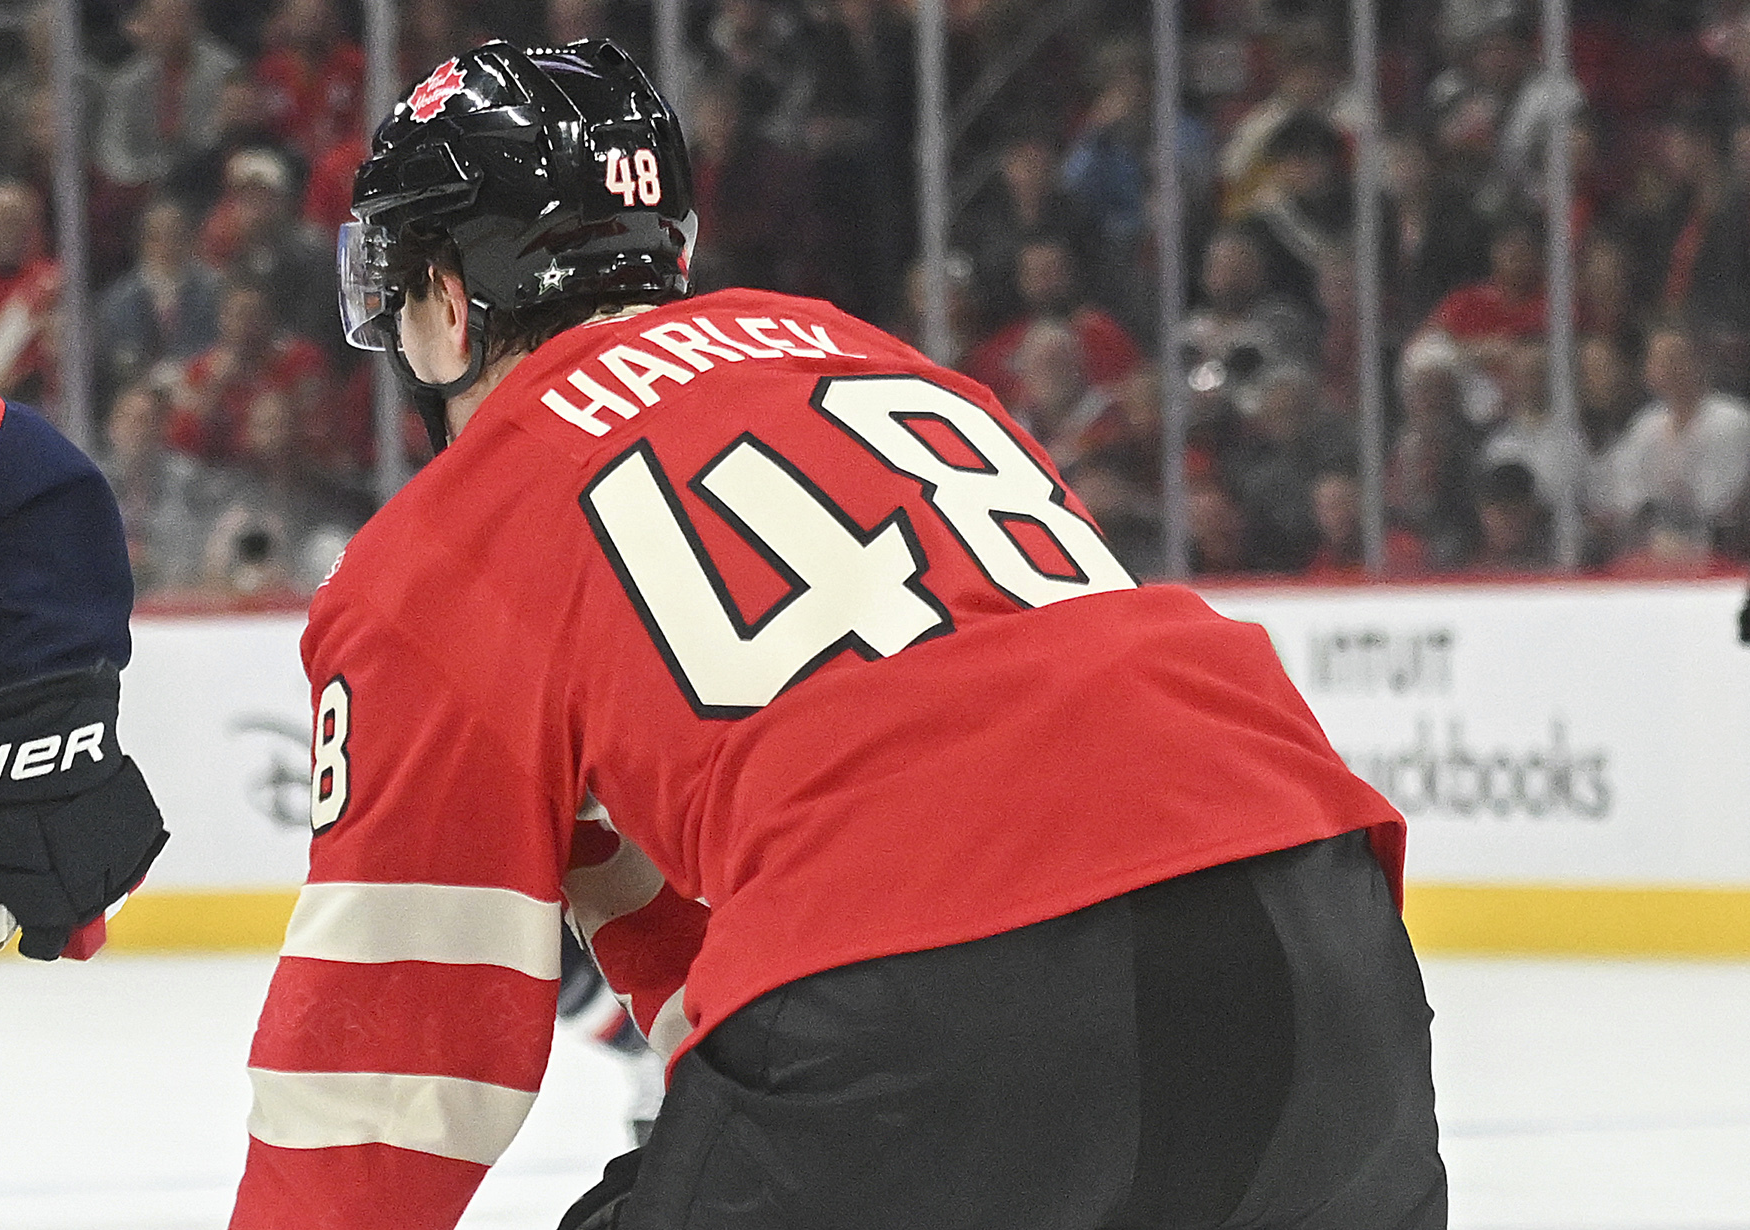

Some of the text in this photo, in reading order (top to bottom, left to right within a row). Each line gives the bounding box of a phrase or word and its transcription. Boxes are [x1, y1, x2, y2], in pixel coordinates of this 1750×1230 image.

[605, 147, 662, 206] 48
[540, 317, 867, 437] HARLEY
[579, 374, 1142, 720] 48
